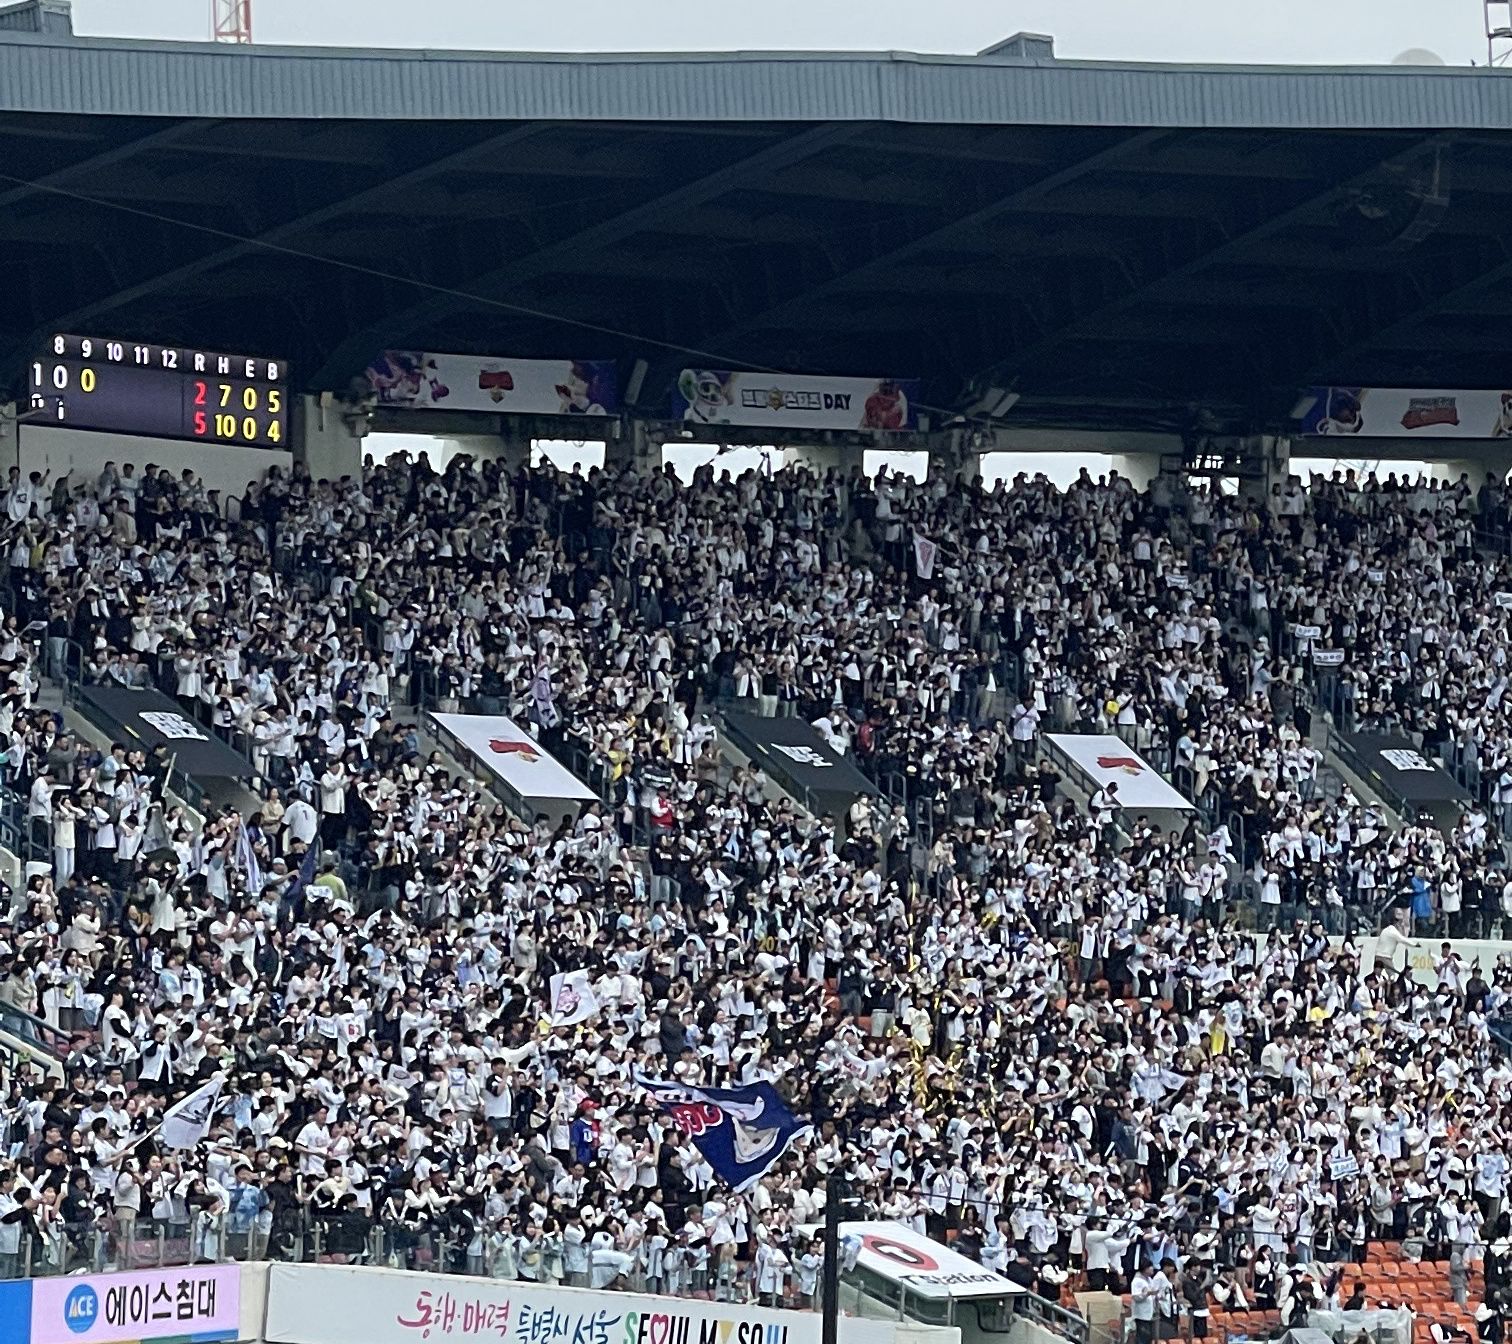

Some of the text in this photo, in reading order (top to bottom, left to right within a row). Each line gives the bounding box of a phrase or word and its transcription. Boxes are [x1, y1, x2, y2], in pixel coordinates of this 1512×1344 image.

[54, 335, 279, 380] 8 9 10 11 12 R H E B
[53, 365, 68, 389] 0
[80, 368, 96, 392] 0
[194, 382, 207, 405] 2
[219, 385, 232, 407] 7
[243, 387, 257, 411] 0
[267, 391, 280, 413] 5
[823, 393, 852, 410] DAY
[193, 412, 207, 435] 5
[215, 414, 237, 438] 10
[242, 417, 257, 440] 0
[267, 420, 281, 443] 4
[68, 1279, 217, 1327] ACE 에이스침대
